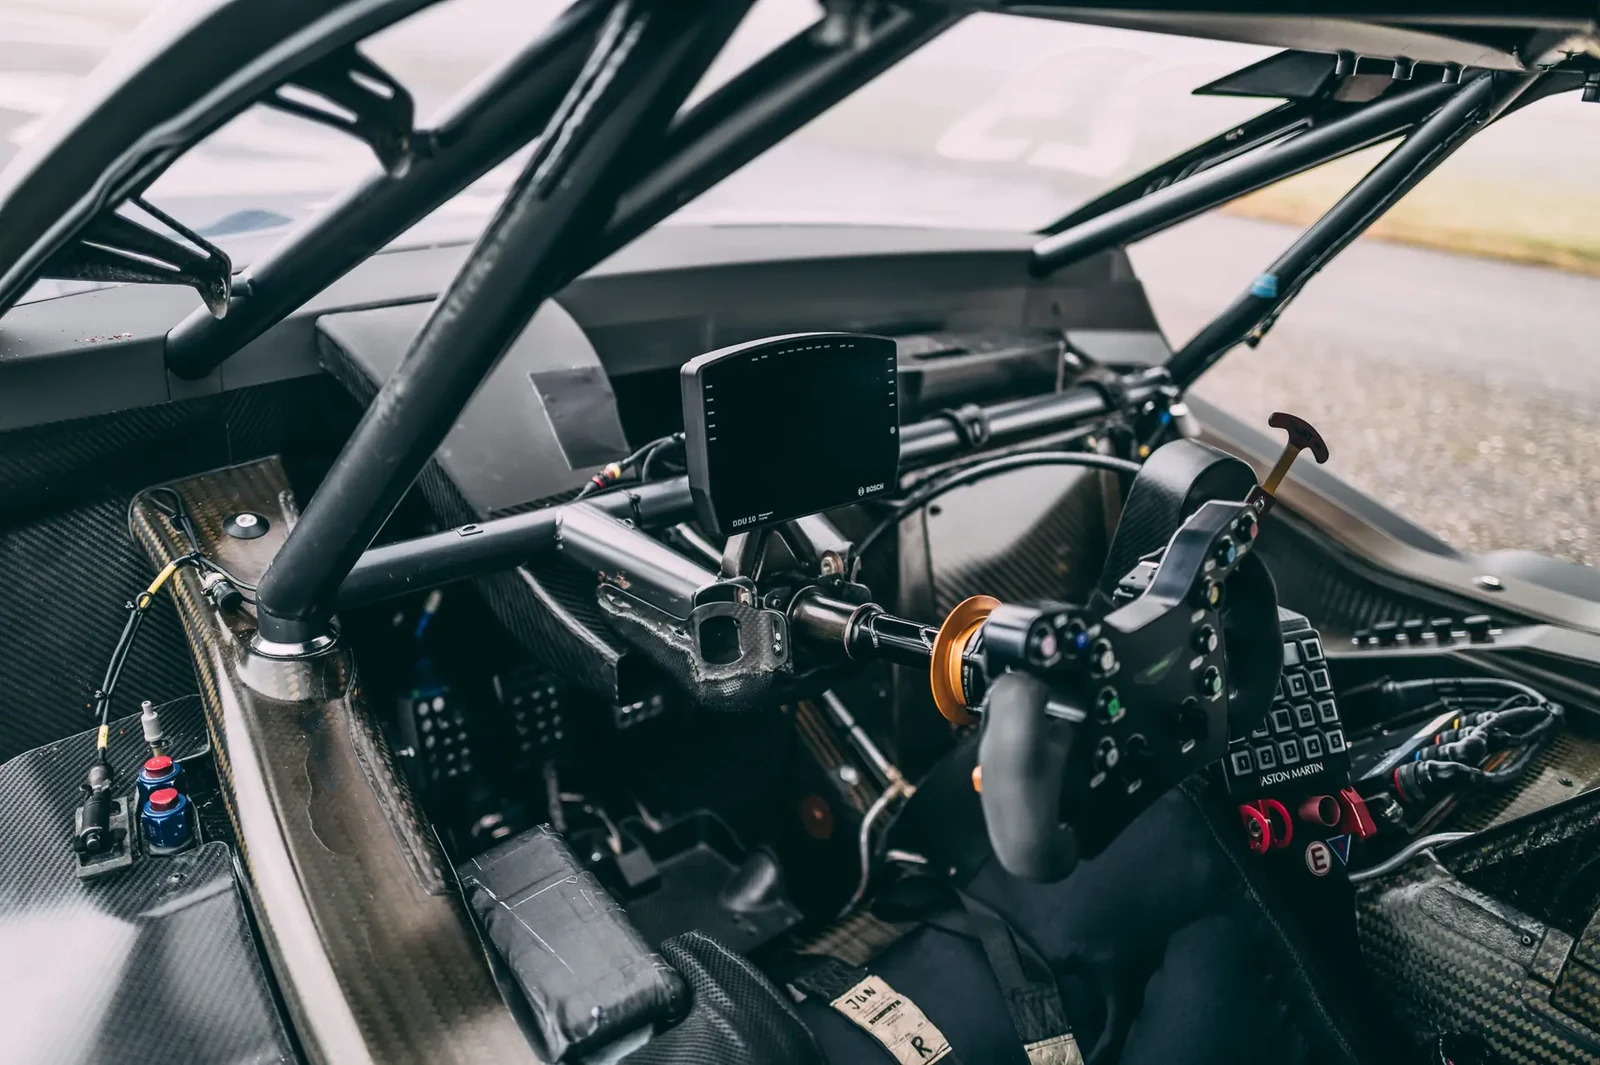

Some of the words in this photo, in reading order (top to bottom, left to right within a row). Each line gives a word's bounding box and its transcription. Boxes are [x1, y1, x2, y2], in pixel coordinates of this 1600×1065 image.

[866, 482, 884, 493] BOSCH
[732, 517, 748, 527] DDU
[748, 515, 757, 524] 10
[1264, 753, 1270, 762] 2
[1288, 747, 1294, 756] 3
[1333, 737, 1339, 746] 5
[1261, 770, 1290, 786] ASTON
[1291, 762, 1324, 779] MARTIN
[1310, 846, 1327, 871] E
[911, 1036, 933, 1058] R
